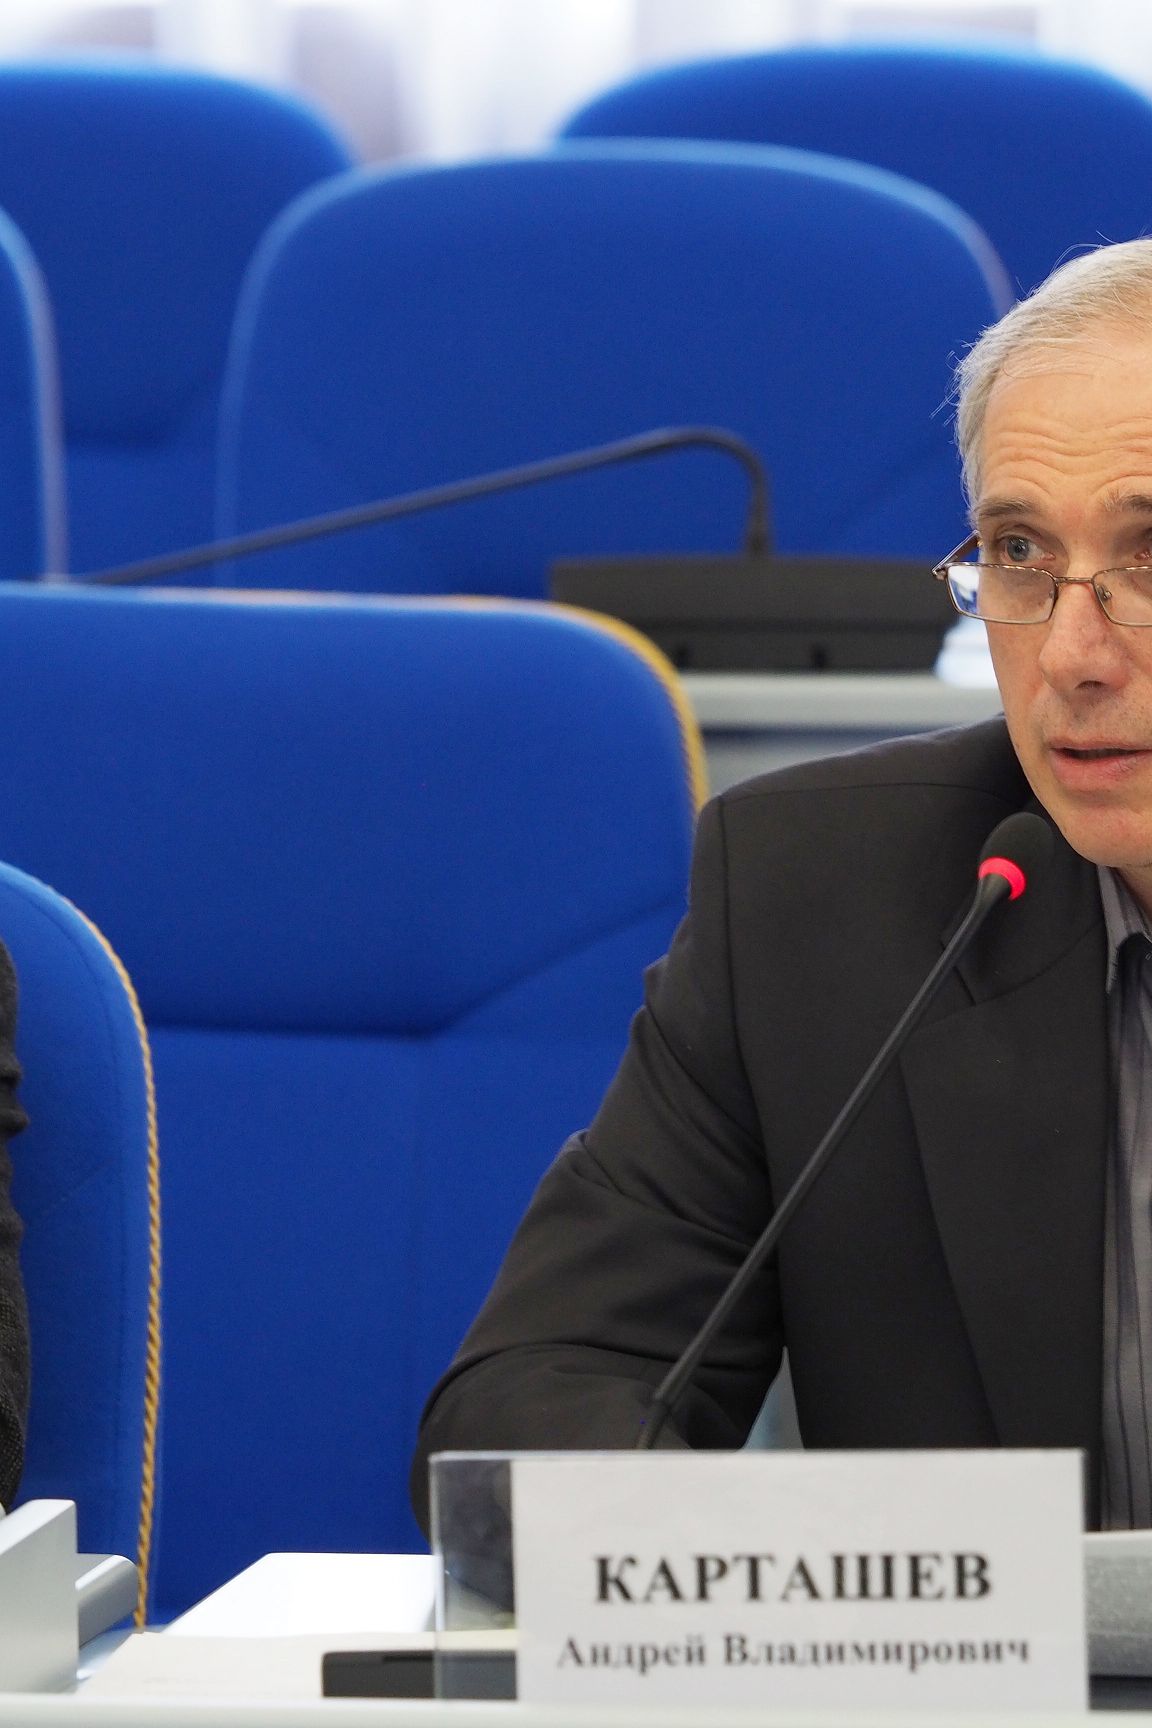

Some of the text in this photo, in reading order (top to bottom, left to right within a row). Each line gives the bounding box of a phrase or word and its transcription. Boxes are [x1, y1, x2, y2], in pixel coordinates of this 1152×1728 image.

[593, 1552, 992, 1602] КАРТАШЕВ
[557, 1633, 1030, 1675] Андрей Владимирович
